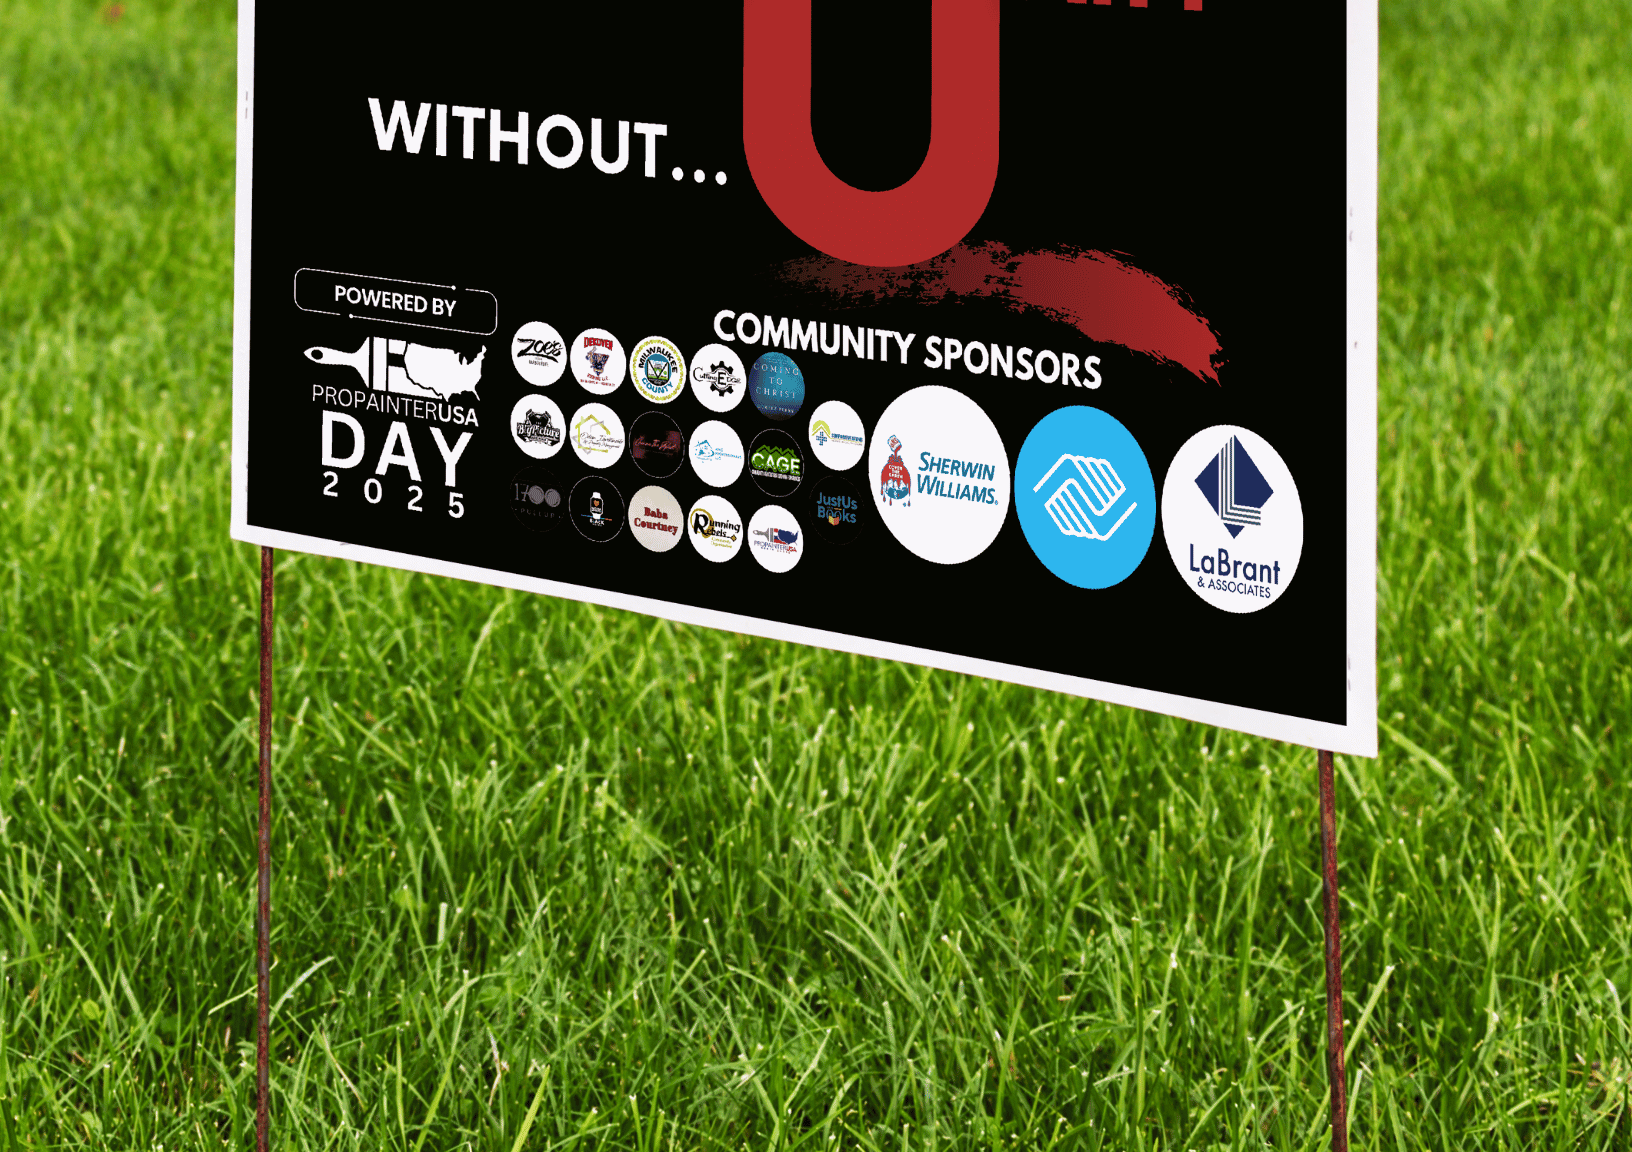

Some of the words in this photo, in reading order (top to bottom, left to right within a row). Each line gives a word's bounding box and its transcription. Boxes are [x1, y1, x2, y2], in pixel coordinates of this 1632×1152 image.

[368, 97, 728, 186] WITHOUT...
[335, 285, 428, 314] POWERED
[432, 298, 457, 318] BY
[638, 347, 678, 374] MILWAUKEE
[713, 309, 916, 364] COMMUNITY
[924, 336, 1102, 390] SPONSORS
[753, 363, 799, 376] COMING
[769, 377, 783, 386] TO
[641, 378, 674, 394] COUNTY
[755, 387, 796, 399] CHRIST
[312, 384, 479, 428] PROPAINTERUSA
[321, 409, 474, 488] DAY
[751, 452, 801, 476] CAGE
[918, 451, 996, 482] SHERWIN
[323, 471, 465, 519] 2025
[644, 507, 669, 520] Baba
[693, 513, 741, 534] Running
[817, 506, 857, 524] Books
[634, 518, 679, 536] Courtney
[1190, 543, 1281, 585] LaBrant
[1197, 576, 1205, 588] &
[1207, 578, 1271, 599] ASSOCIATES
